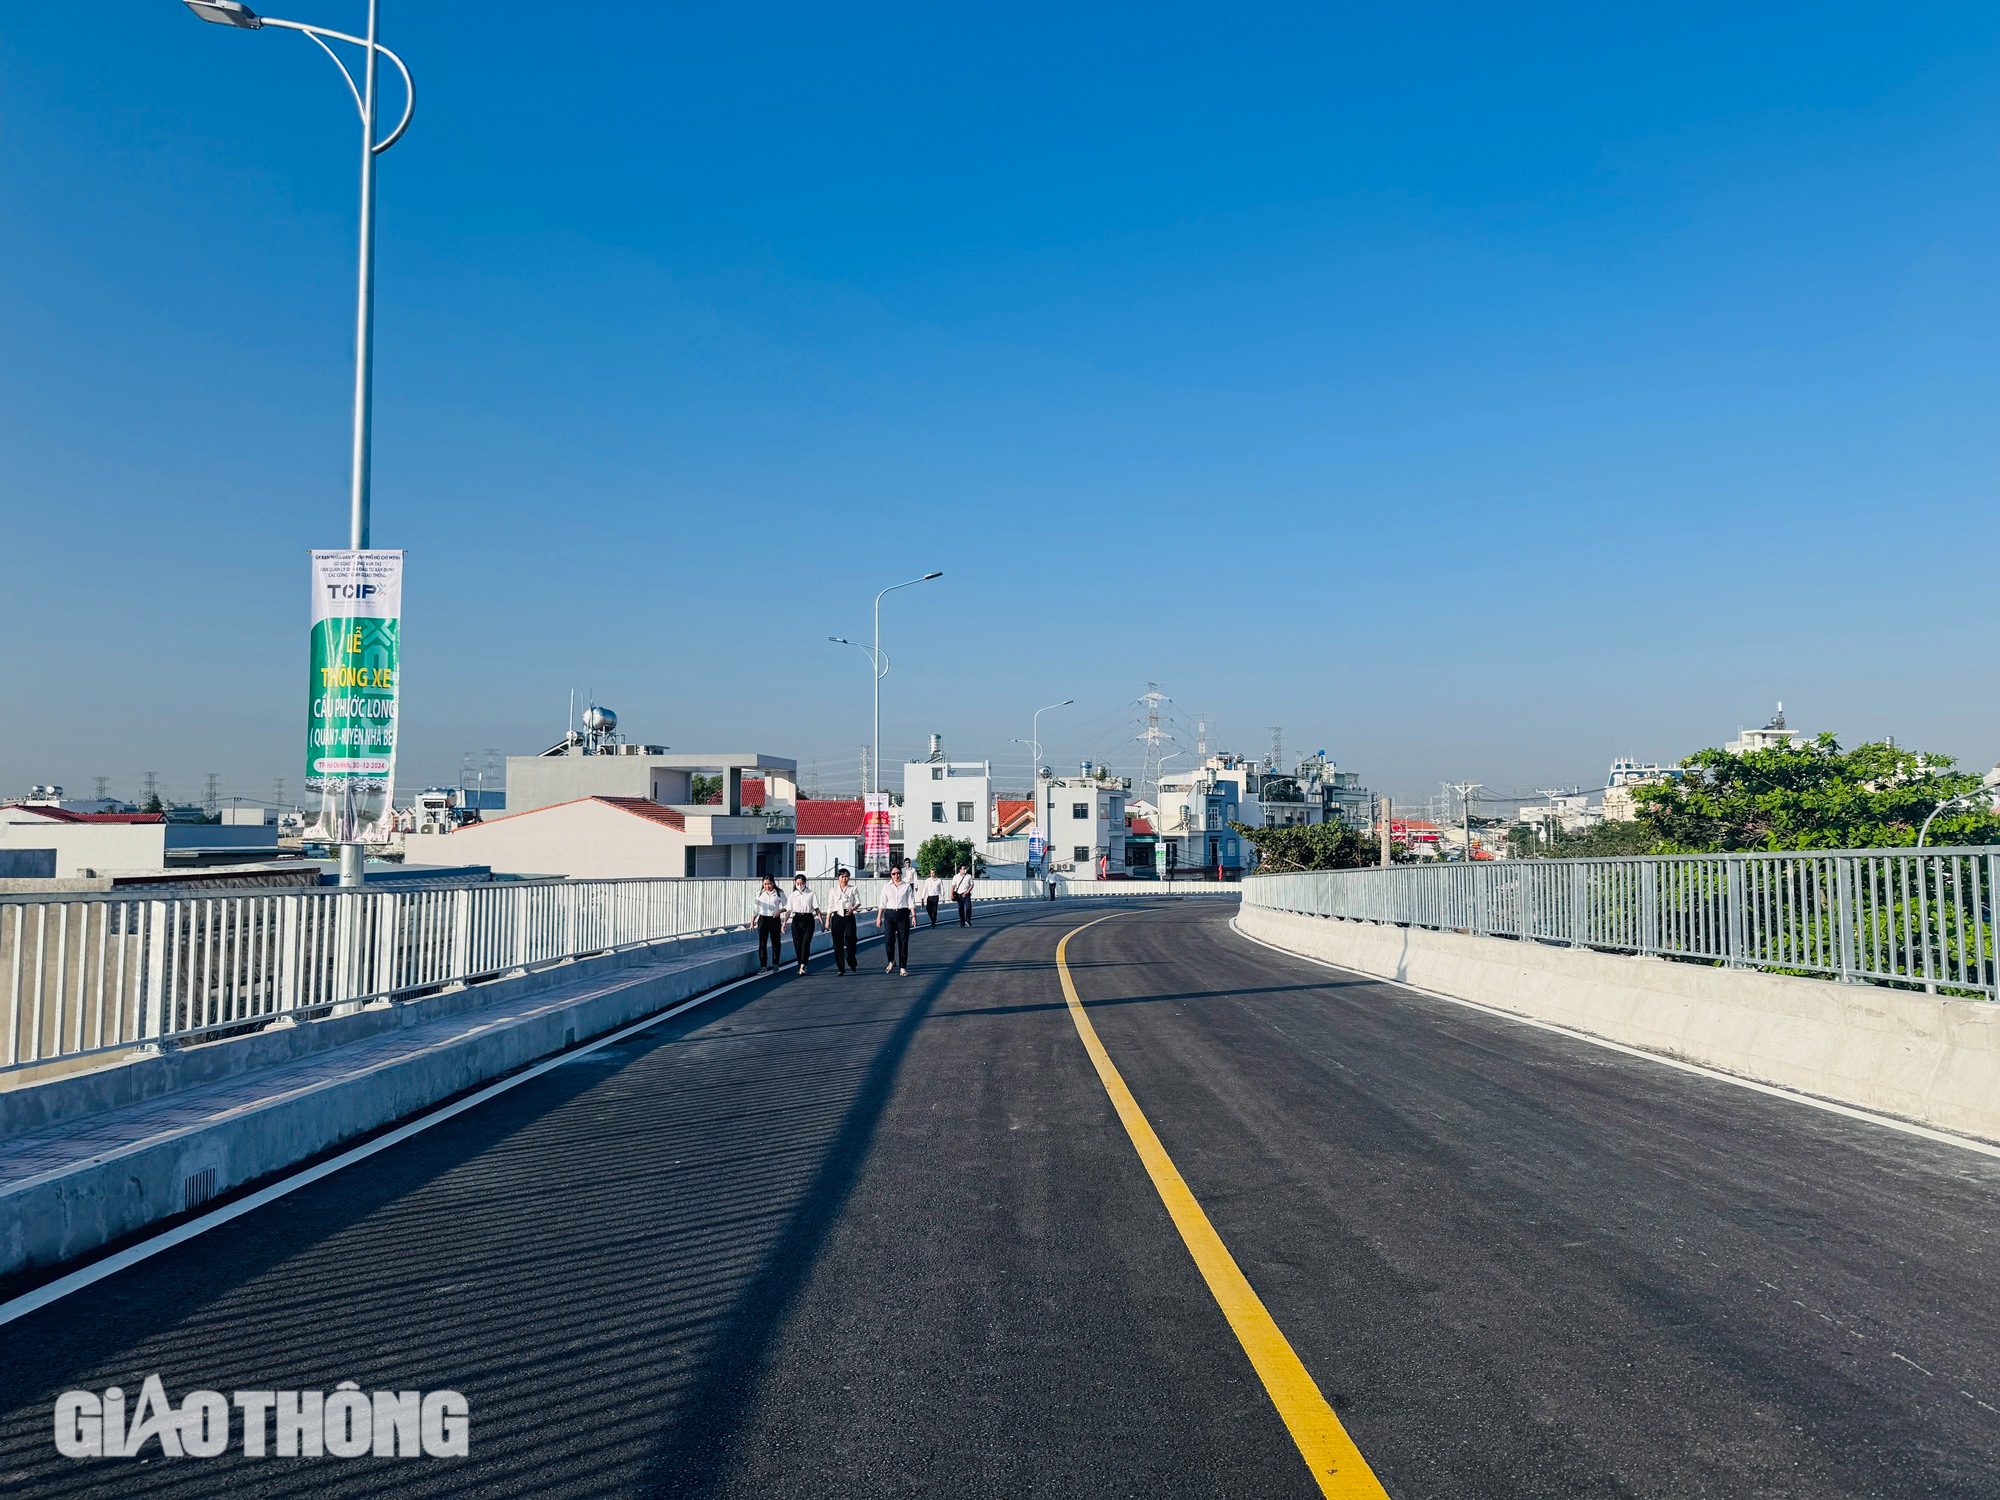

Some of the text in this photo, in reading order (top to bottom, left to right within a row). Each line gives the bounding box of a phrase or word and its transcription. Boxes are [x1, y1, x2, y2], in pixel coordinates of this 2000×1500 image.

[327, 584, 377, 599] TCIP
[346, 626, 362, 653] LỄ
[320, 664, 391, 688] THÔNG XE
[314, 693, 395, 719] CẦU PHƯỚC LONG
